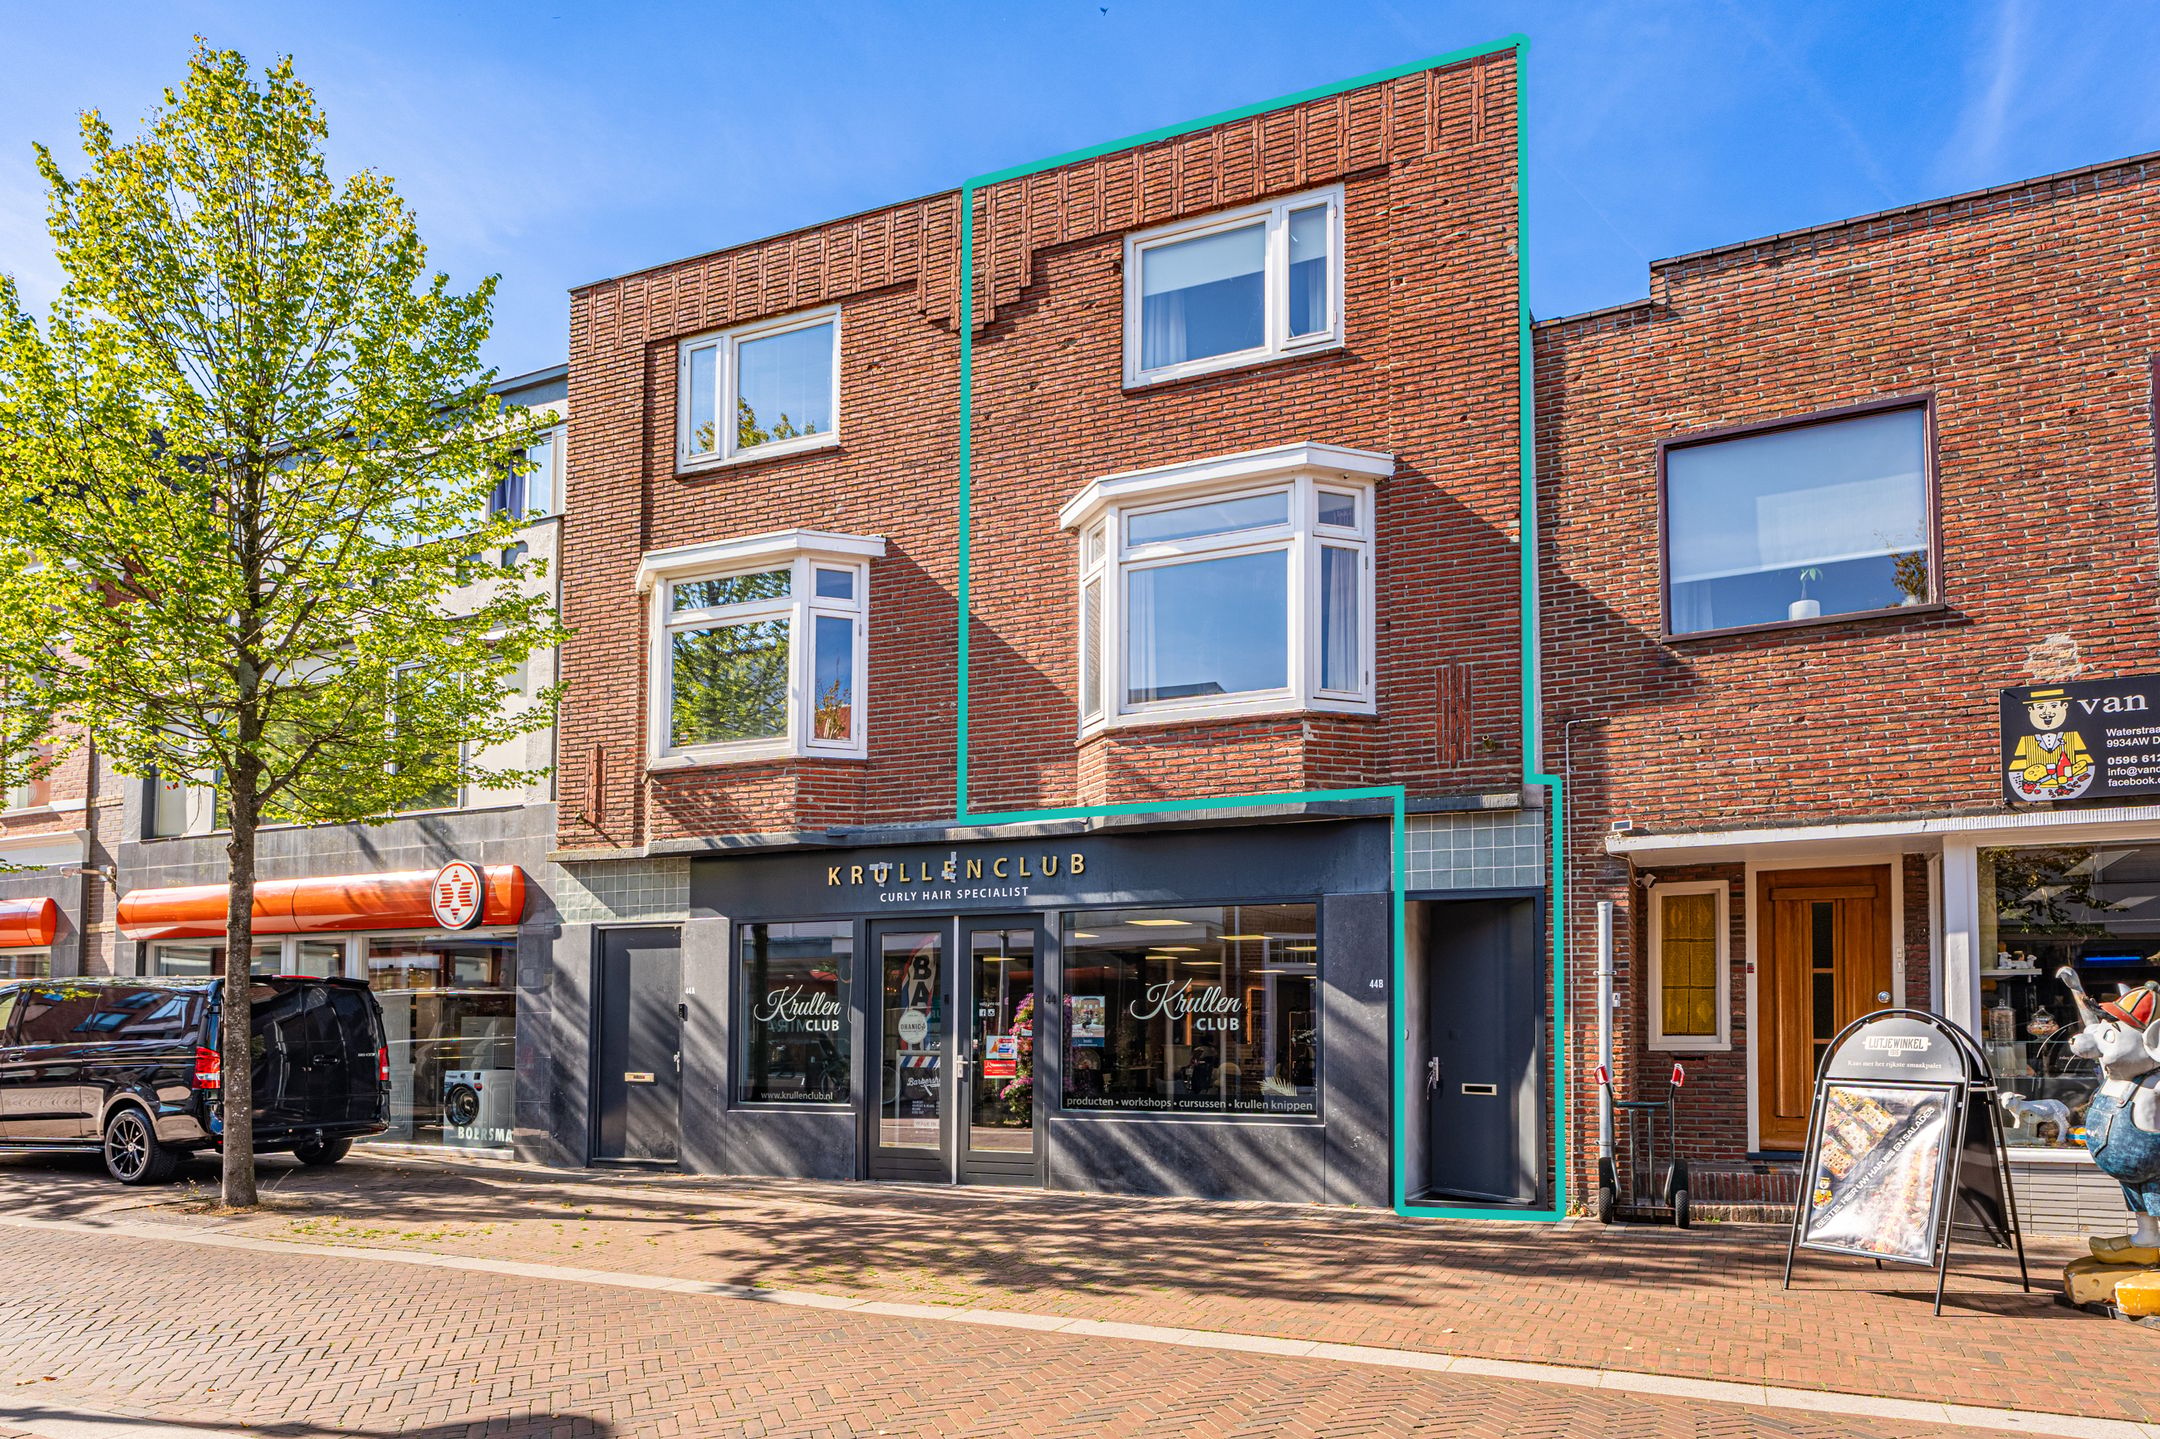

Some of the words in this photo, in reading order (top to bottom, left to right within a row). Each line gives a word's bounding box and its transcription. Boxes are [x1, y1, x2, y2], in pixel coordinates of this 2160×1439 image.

[2077, 694, 2149, 715] van
[2106, 737, 2150, 748] 9934AW
[2107, 755, 2138, 765] 0596
[828, 853, 1086, 887] KRULLENCLUB
[880, 891, 917, 902] CURLY
[922, 889, 952, 901] HAIR
[957, 886, 1029, 899] SPECIALIST
[685, 986, 695, 995] 44A
[1369, 979, 1384, 988] 44B
[754, 984, 842, 1022] Krullen
[1045, 994, 1056, 1004] 44
[1130, 977, 1242, 1021] Krullen
[806, 1020, 840, 1032] CLUB
[1196, 1017, 1240, 1031] CLUB
[1869, 1037, 1924, 1050] LUTJEWINKEL
[760, 1091, 833, 1101] www.krullenclub.nl
[1067, 1096, 1114, 1108] producten
[1121, 1096, 1172, 1109] workshops
[1179, 1099, 1226, 1109] cursussen
[1234, 1099, 1269, 1110] krullen
[1271, 1100, 1313, 1112] knippen
[458, 1126, 514, 1143] BOERSMA
[1816, 1205, 1843, 1229] BESTEL
[1840, 1188, 1858, 1204] HIER
[1855, 1174, 1869, 1190] UW
[1867, 1149, 1896, 1178] HAPJES
[1893, 1139, 1906, 1152] EN
[1902, 1106, 1935, 1141] SALADES
